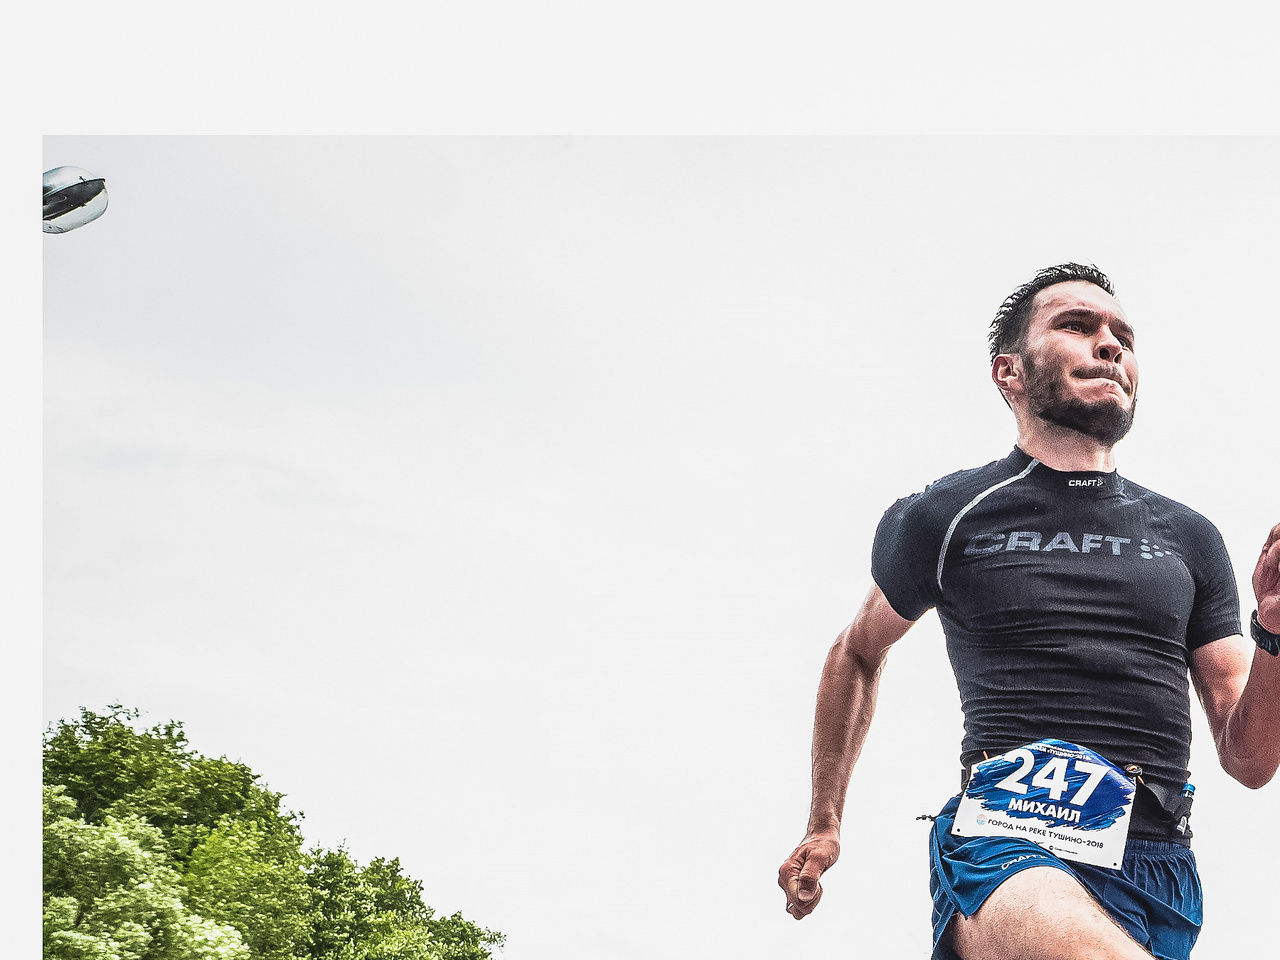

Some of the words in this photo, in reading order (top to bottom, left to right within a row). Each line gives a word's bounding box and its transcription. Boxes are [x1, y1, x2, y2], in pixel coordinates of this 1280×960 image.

[1068, 479, 1097, 487] CRAFT
[963, 531, 1131, 556] CRAFT
[994, 747, 1111, 807] 247
[1008, 797, 1081, 823] МИХАИЛ
[987, 818, 1014, 831] ГОРОД
[1015, 824, 1028, 833] НА
[1028, 827, 1047, 837] РЕКЕ
[1048, 830, 1104, 849] ТУШИНО-2018
